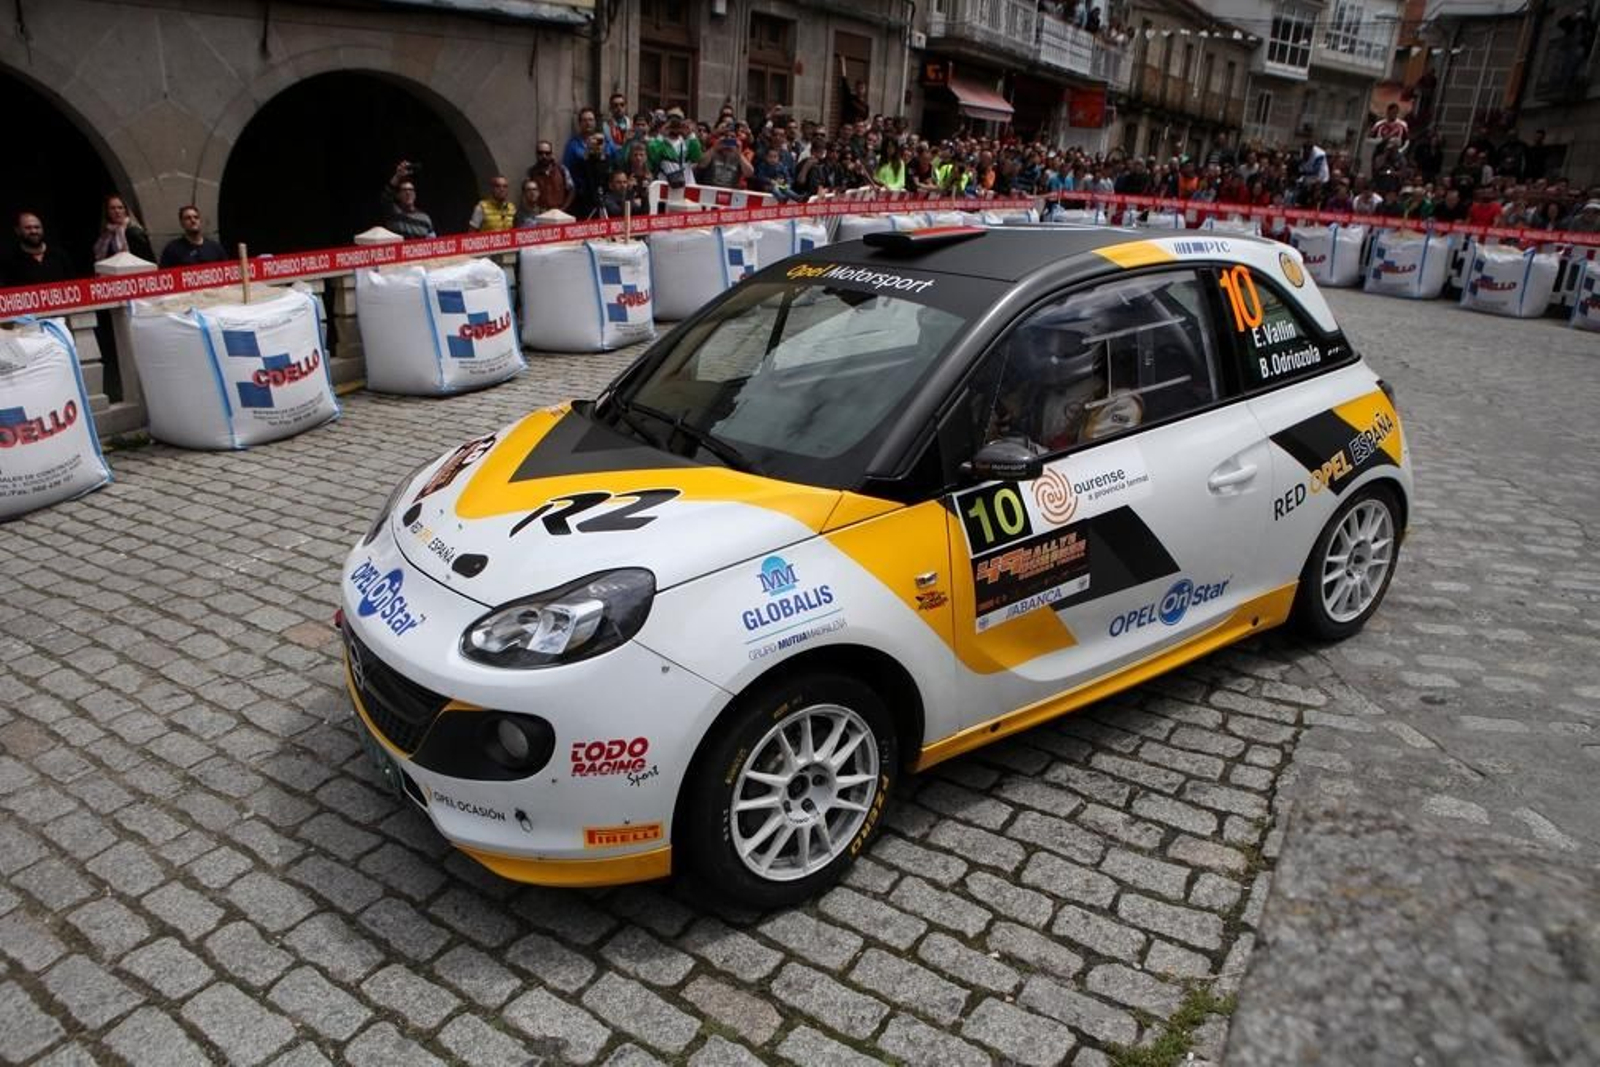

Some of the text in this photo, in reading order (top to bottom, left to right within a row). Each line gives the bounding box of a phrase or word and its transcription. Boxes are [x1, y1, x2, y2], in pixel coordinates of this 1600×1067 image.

[181, 262, 257, 289] PROHIBIDO PUBO
[263, 252, 331, 277] PROHIBIDO PUBLICO
[786, 263, 934, 293] Opel Motorsport
[0, 284, 82, 314] OHIBIDO PUBLICO
[89, 272, 175, 301] PROHIBIDO PUBLICO
[616, 289, 650, 307] COELL
[1219, 264, 1265, 333] 10
[252, 347, 321, 389] COELLO
[1073, 469, 1126, 495] ourense
[1273, 412, 1394, 522] RED OPEL ESPAÑA
[967, 487, 1025, 545] 10
[350, 561, 382, 597] OPEL
[741, 584, 834, 632] GLOBALIS
[1006, 588, 1063, 619] ABANCA
[1108, 602, 1158, 638] OPEL
[570, 757, 647, 778] RACING
[433, 790, 457, 809] OPEL
[586, 824, 661, 846] PIRELLI
